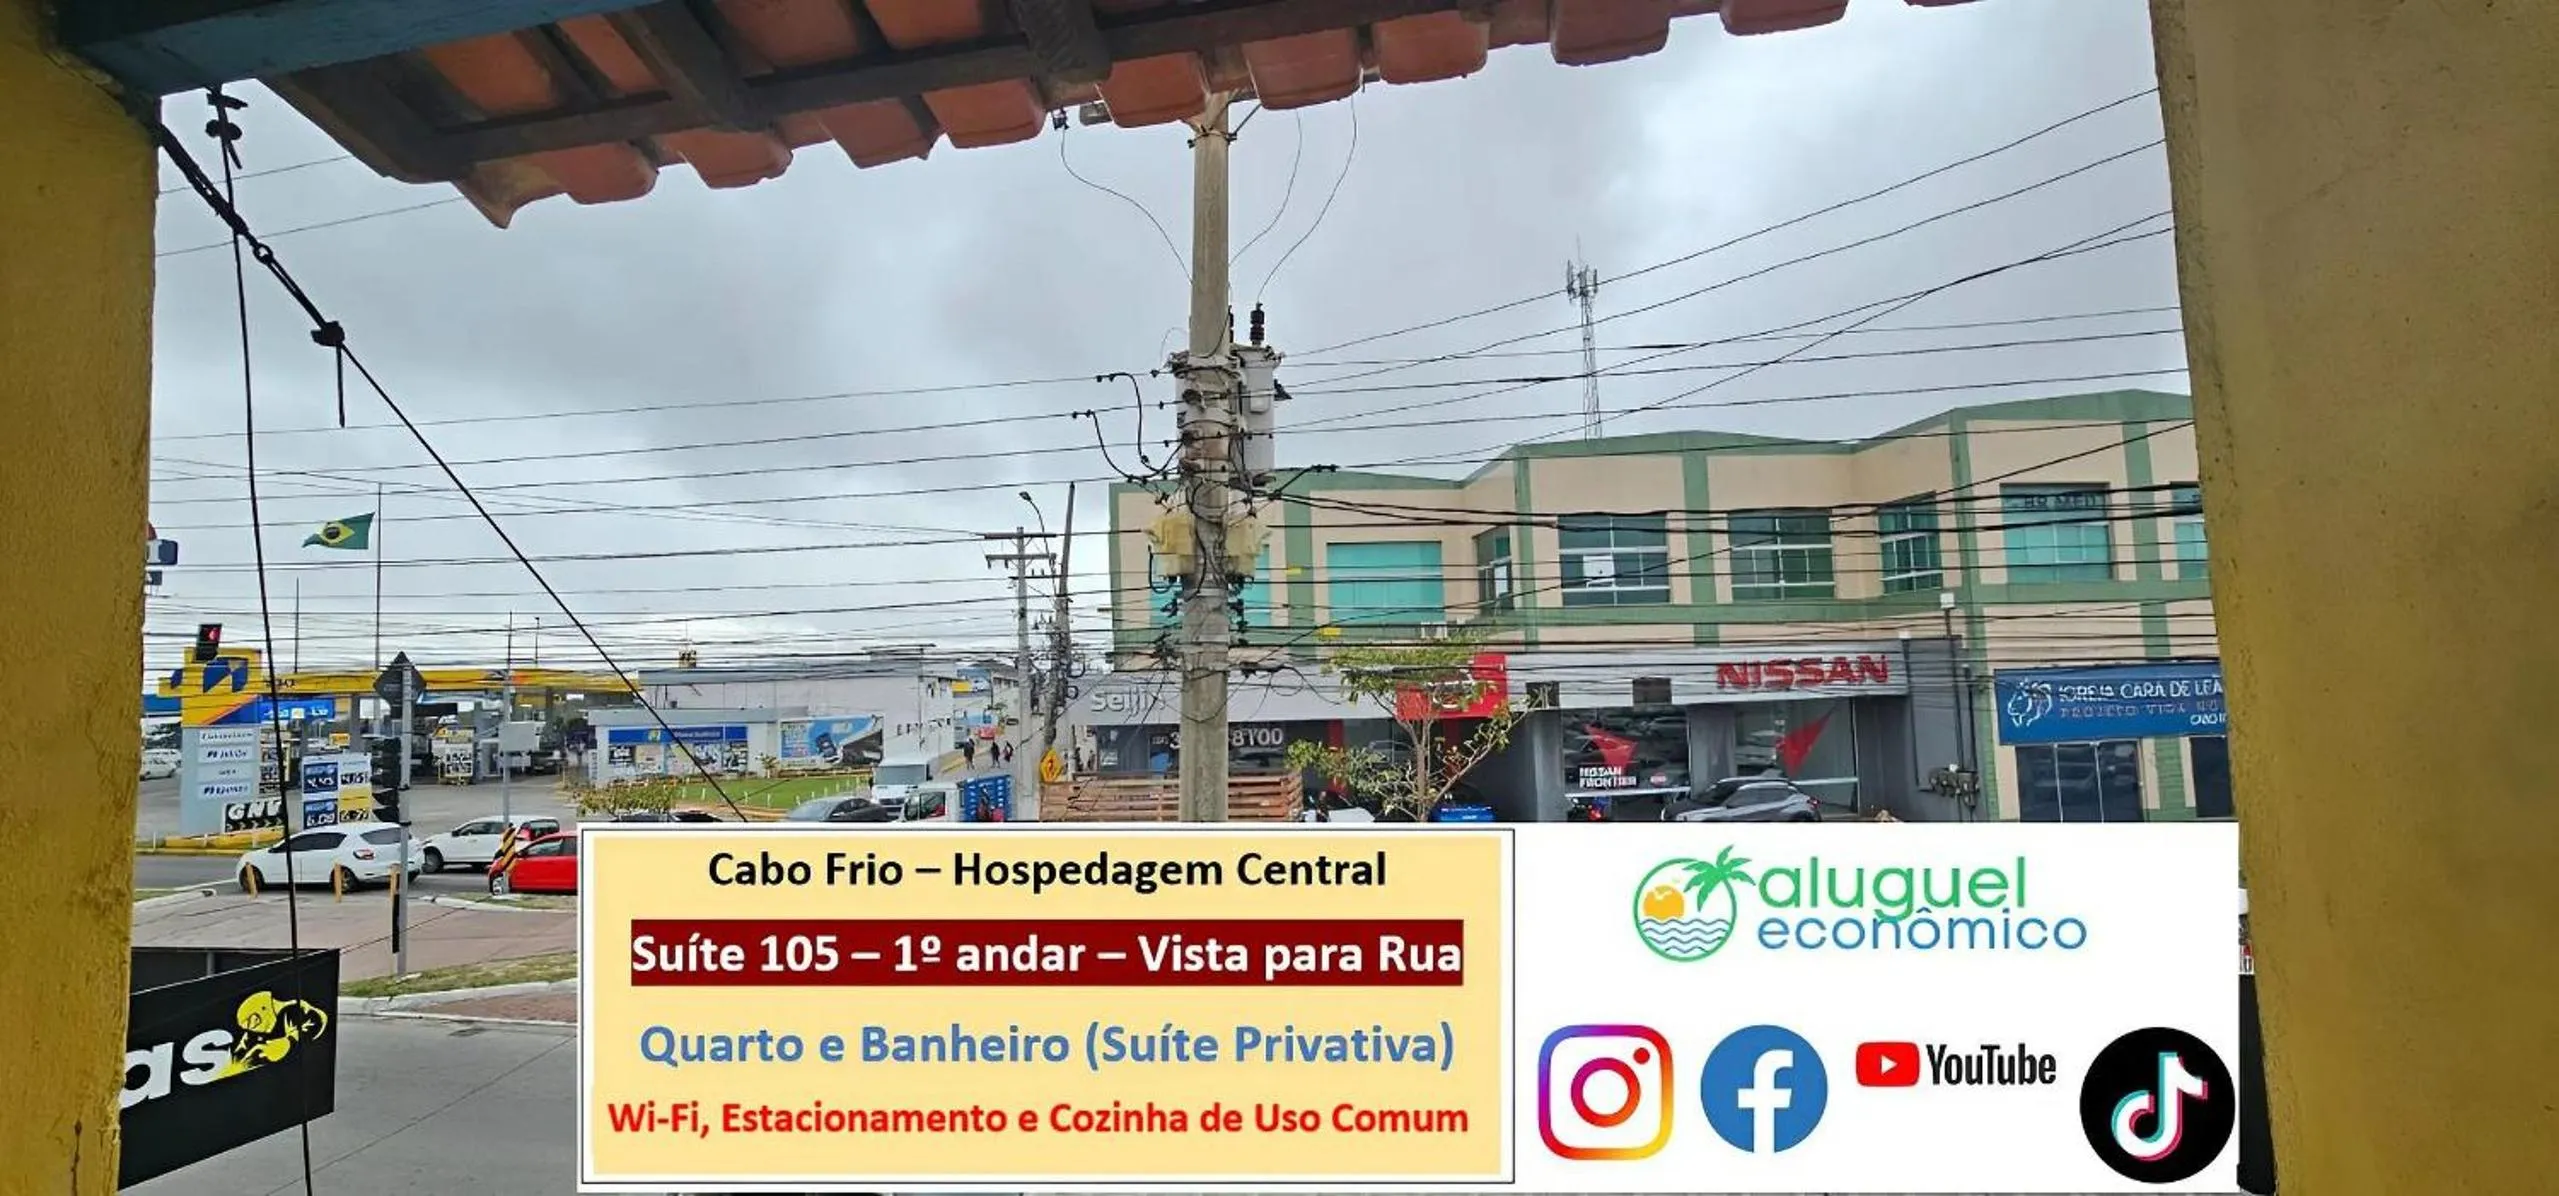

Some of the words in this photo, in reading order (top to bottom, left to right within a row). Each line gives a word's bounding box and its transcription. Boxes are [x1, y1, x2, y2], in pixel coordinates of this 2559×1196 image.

[1717, 655, 1888, 690] NISSAN
[2170, 680, 2190, 698] DE
[228, 797, 282, 820] GNV
